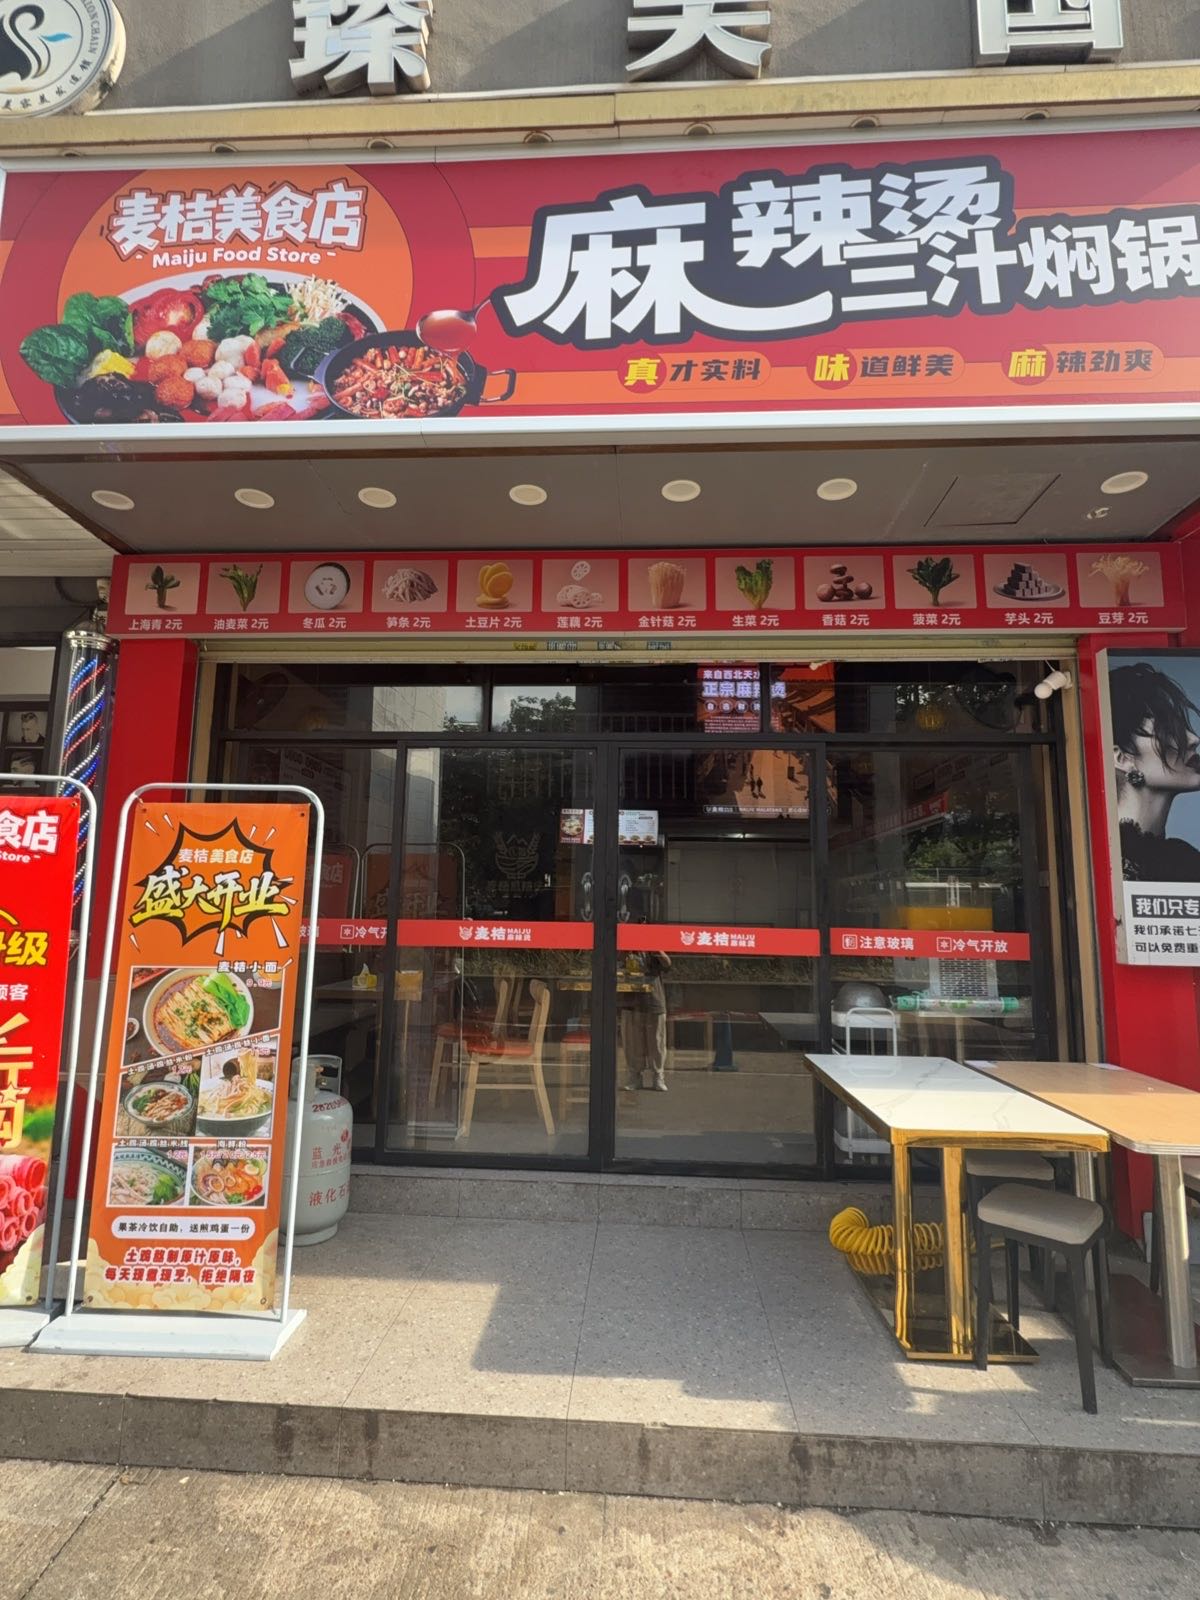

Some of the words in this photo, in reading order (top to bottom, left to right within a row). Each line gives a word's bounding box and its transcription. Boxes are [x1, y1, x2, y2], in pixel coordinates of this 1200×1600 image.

[113, 183, 364, 253] 麦桔美食店
[153, 252, 207, 268] Maiju
[213, 248, 261, 263] Food
[266, 247, 321, 265] Store
[505, 166, 1001, 340] 麻辣烫
[840, 215, 1200, 312] 三汁焖锅
[814, 353, 954, 383] 味道鲜美
[1008, 348, 1154, 379] 麻辣劲爽
[624, 357, 761, 386] 真才实料
[128, 619, 162, 631] 上海青
[165, 618, 183, 630] 2元
[214, 618, 248, 630] 油麦菜
[251, 618, 269, 630] 2元
[302, 617, 326, 629] 冬瓜
[329, 617, 347, 629] 2元
[413, 617, 431, 629] 2元
[465, 617, 501, 628] 土豆片
[504, 617, 522, 628] 2元
[584, 616, 603, 628] 2元
[638, 615, 675, 628] 金针菇
[678, 616, 697, 628] 2元
[732, 615, 757, 627] 生菜
[760, 615, 779, 627] 2元
[822, 613, 847, 626] 香菇
[850, 614, 870, 626] 2元
[912, 613, 938, 626] 菠菜
[941, 613, 961, 626] 2元
[1004, 612, 1030, 625] 芋头
[1033, 612, 1054, 625] 2元
[1098, 611, 1125, 625] 豆芽
[1128, 612, 1149, 625] 2元
[178, 848, 254, 864] 麦桔美食店
[130, 865, 290, 932] 盛大开业
[474, 925, 506, 941] 麦桔
[1134, 924, 1200, 937] 我们承诺七
[697, 931, 729, 946] 麦桔
[859, 935, 914, 951] 注意玻璃
[0, 931, 48, 966] 级
[953, 939, 1008, 953] 冷气开放
[1135, 942, 1198, 953] 可以免费重
